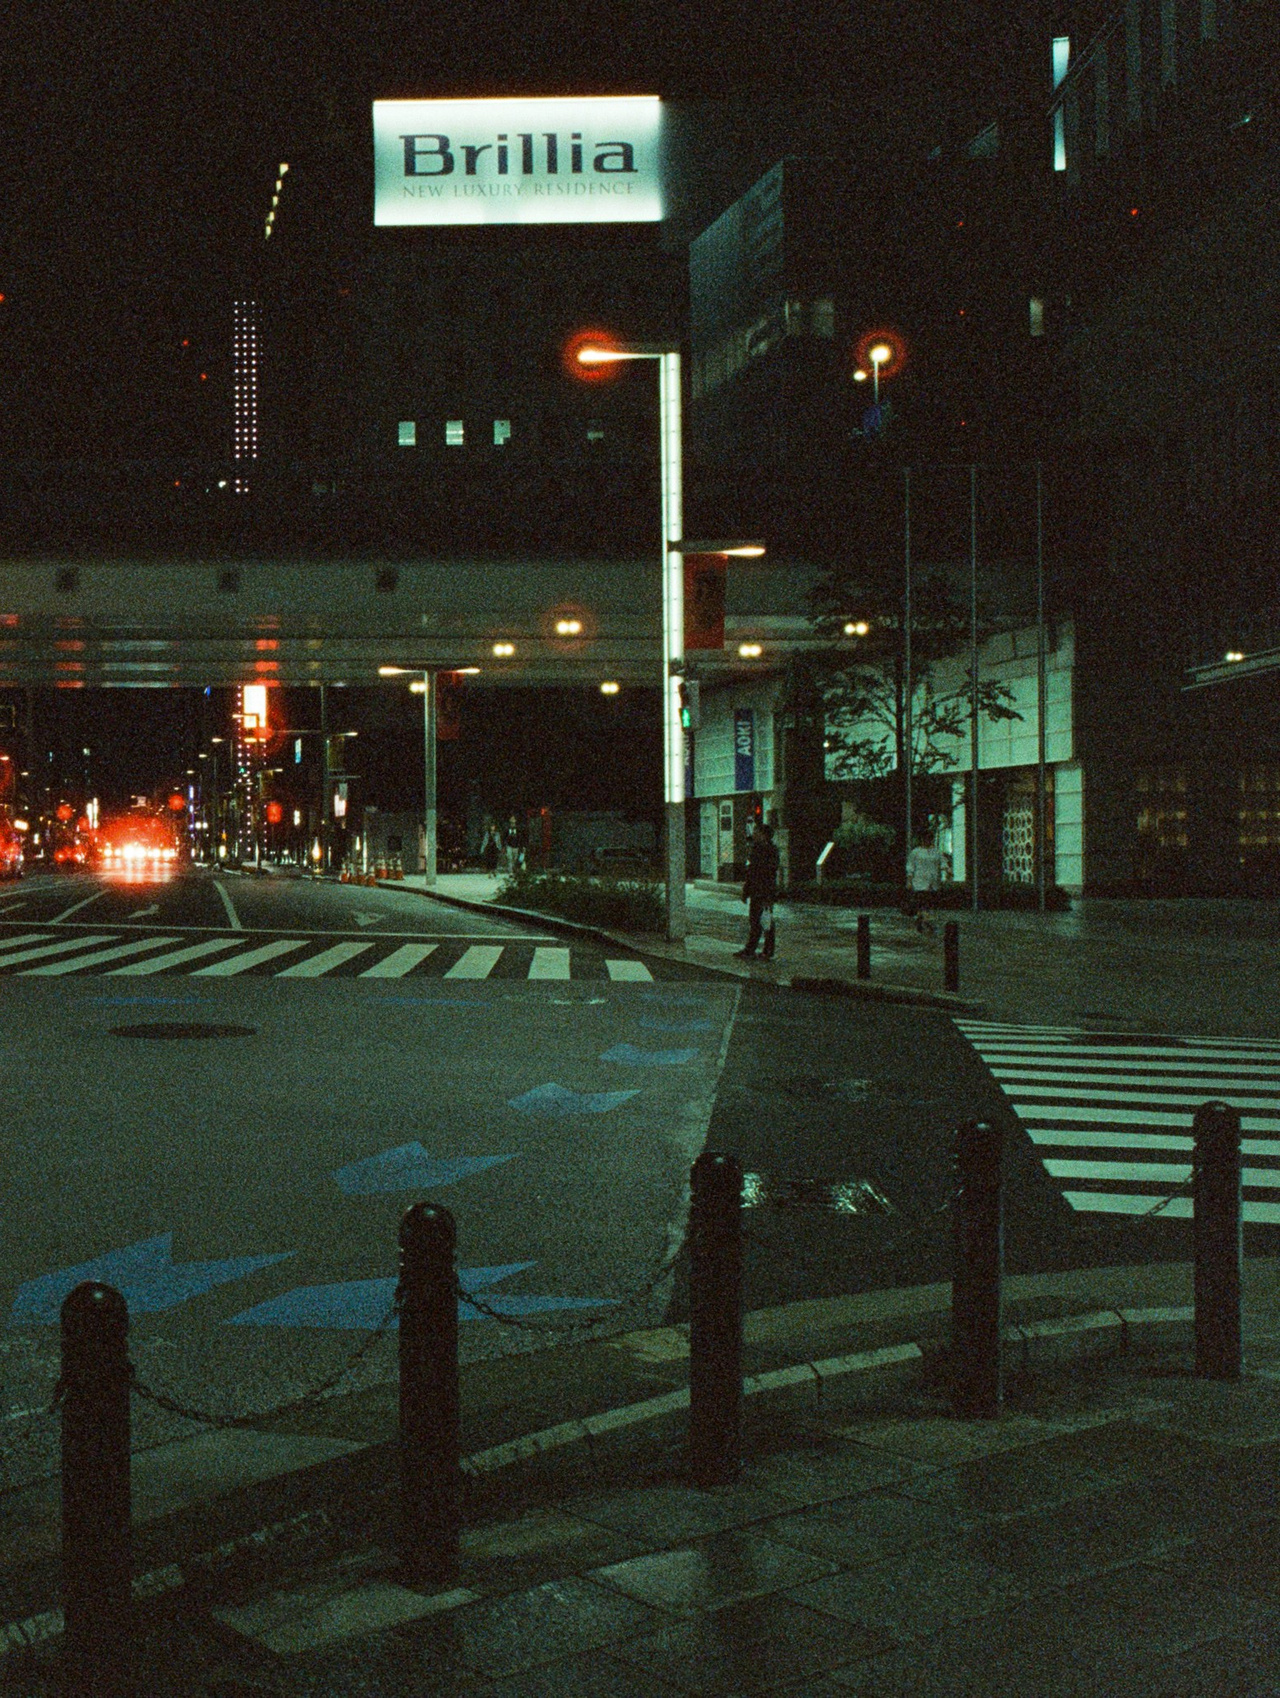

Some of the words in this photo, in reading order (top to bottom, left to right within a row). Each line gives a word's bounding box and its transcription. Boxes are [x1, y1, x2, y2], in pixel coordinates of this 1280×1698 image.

[398, 132, 639, 178] Brillia
[403, 184, 445, 199] NEW
[454, 183, 523, 198] LUXURY
[534, 182, 635, 197] RESIDENCE
[736, 720, 752, 756] AOKI
